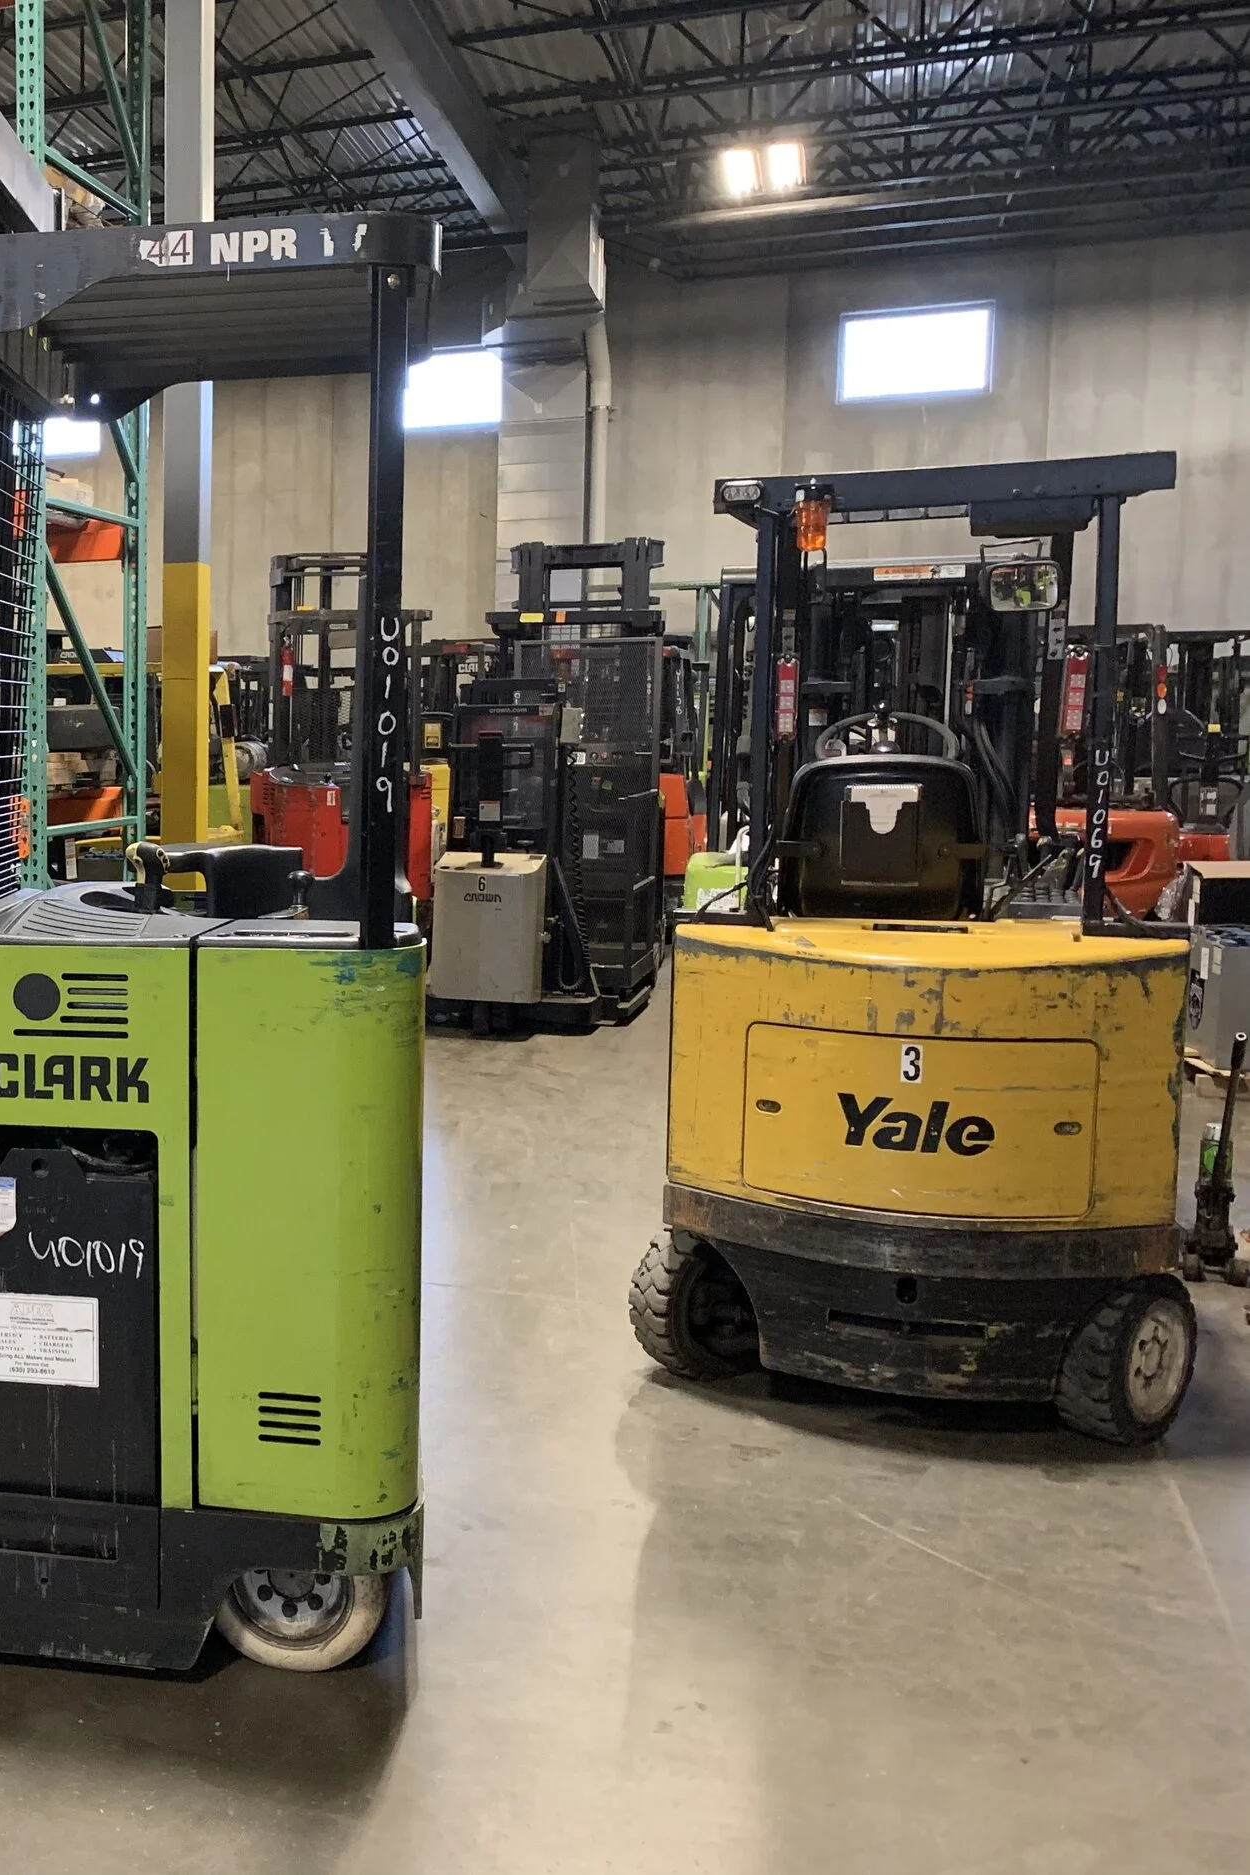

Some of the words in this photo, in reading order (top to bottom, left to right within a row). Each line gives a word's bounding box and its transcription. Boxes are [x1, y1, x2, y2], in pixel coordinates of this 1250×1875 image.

[210, 228, 297, 265] NPR
[375, 616, 400, 814] U01019
[1088, 749, 1110, 879] U01069
[478, 876, 486, 892] 6
[903, 1046, 921, 1081] 3
[837, 1092, 996, 1157] Yale
